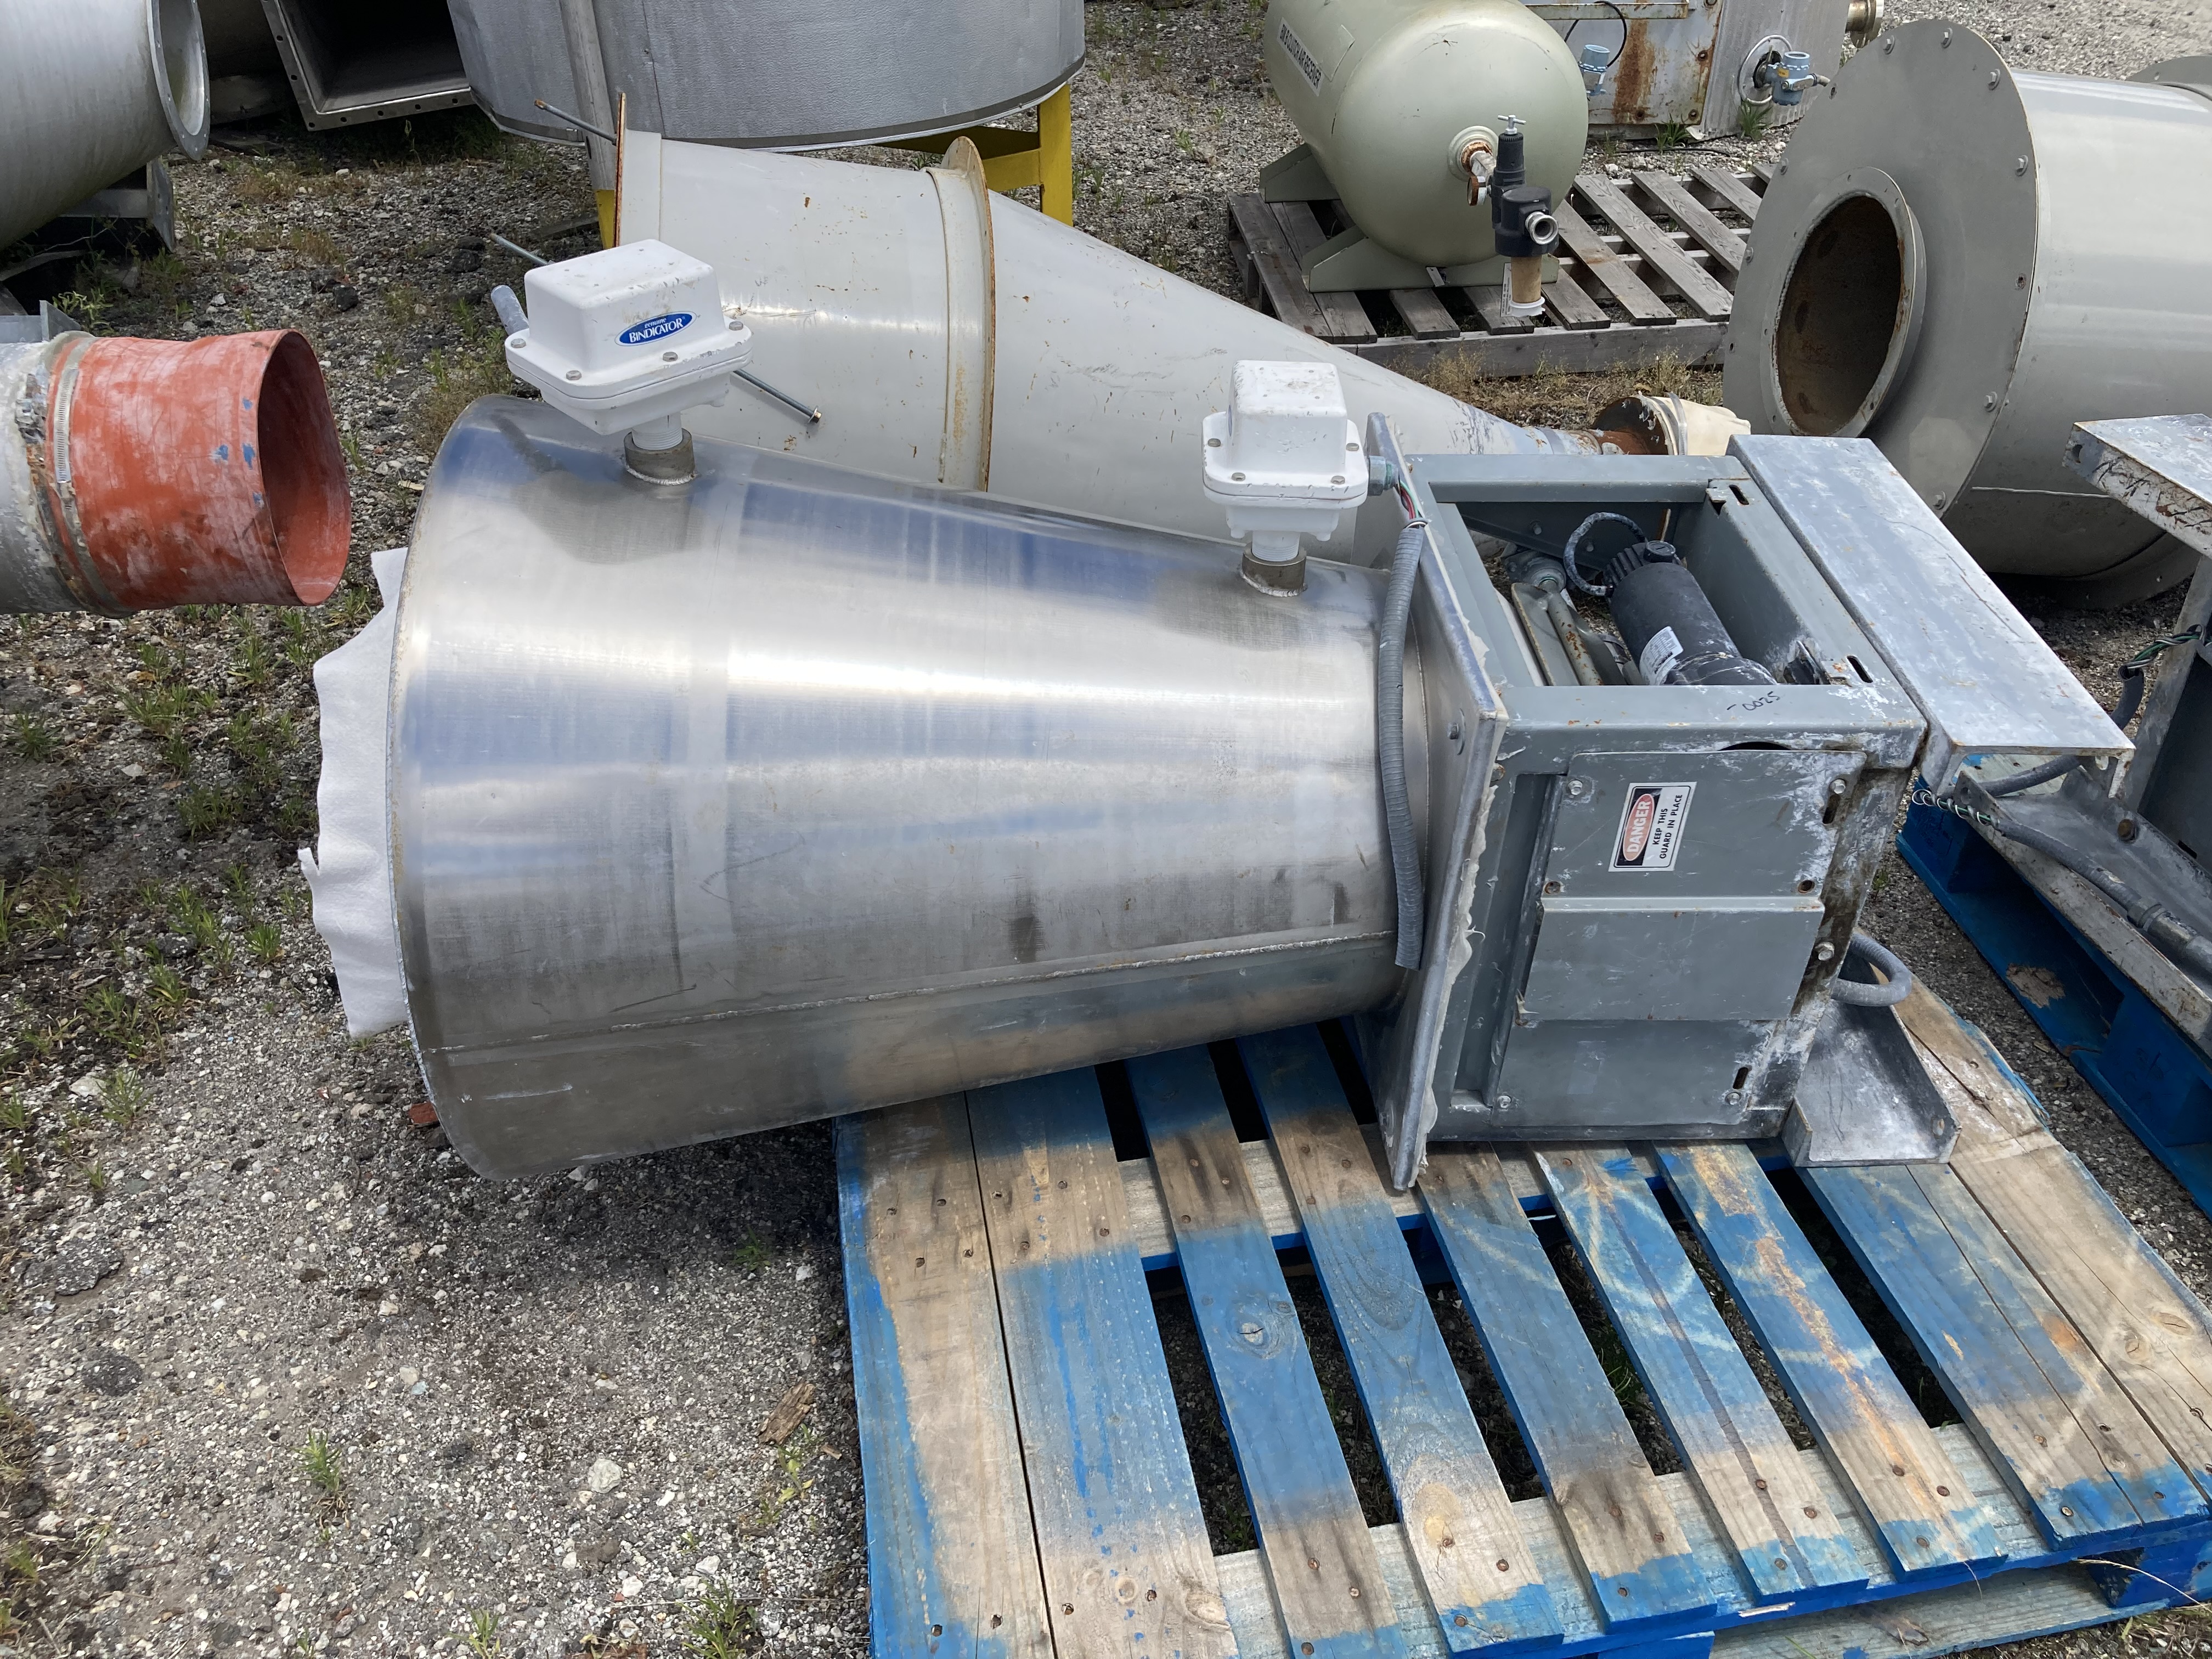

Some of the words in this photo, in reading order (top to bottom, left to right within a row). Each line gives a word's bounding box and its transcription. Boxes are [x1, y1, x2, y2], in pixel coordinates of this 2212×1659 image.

[1303, 54, 1322, 89] RECEIVER
[629, 318, 684, 343] BINDICATOR
[644, 318, 667, 329] genuine
[1670, 794, 1683, 816] PLACE
[1627, 801, 1651, 853] DANGER
[1652, 828, 1662, 845] KEEP
[1657, 808, 1668, 824] THIS
[1667, 820, 1675, 828] IN
[1660, 832, 1672, 859] GUARD
